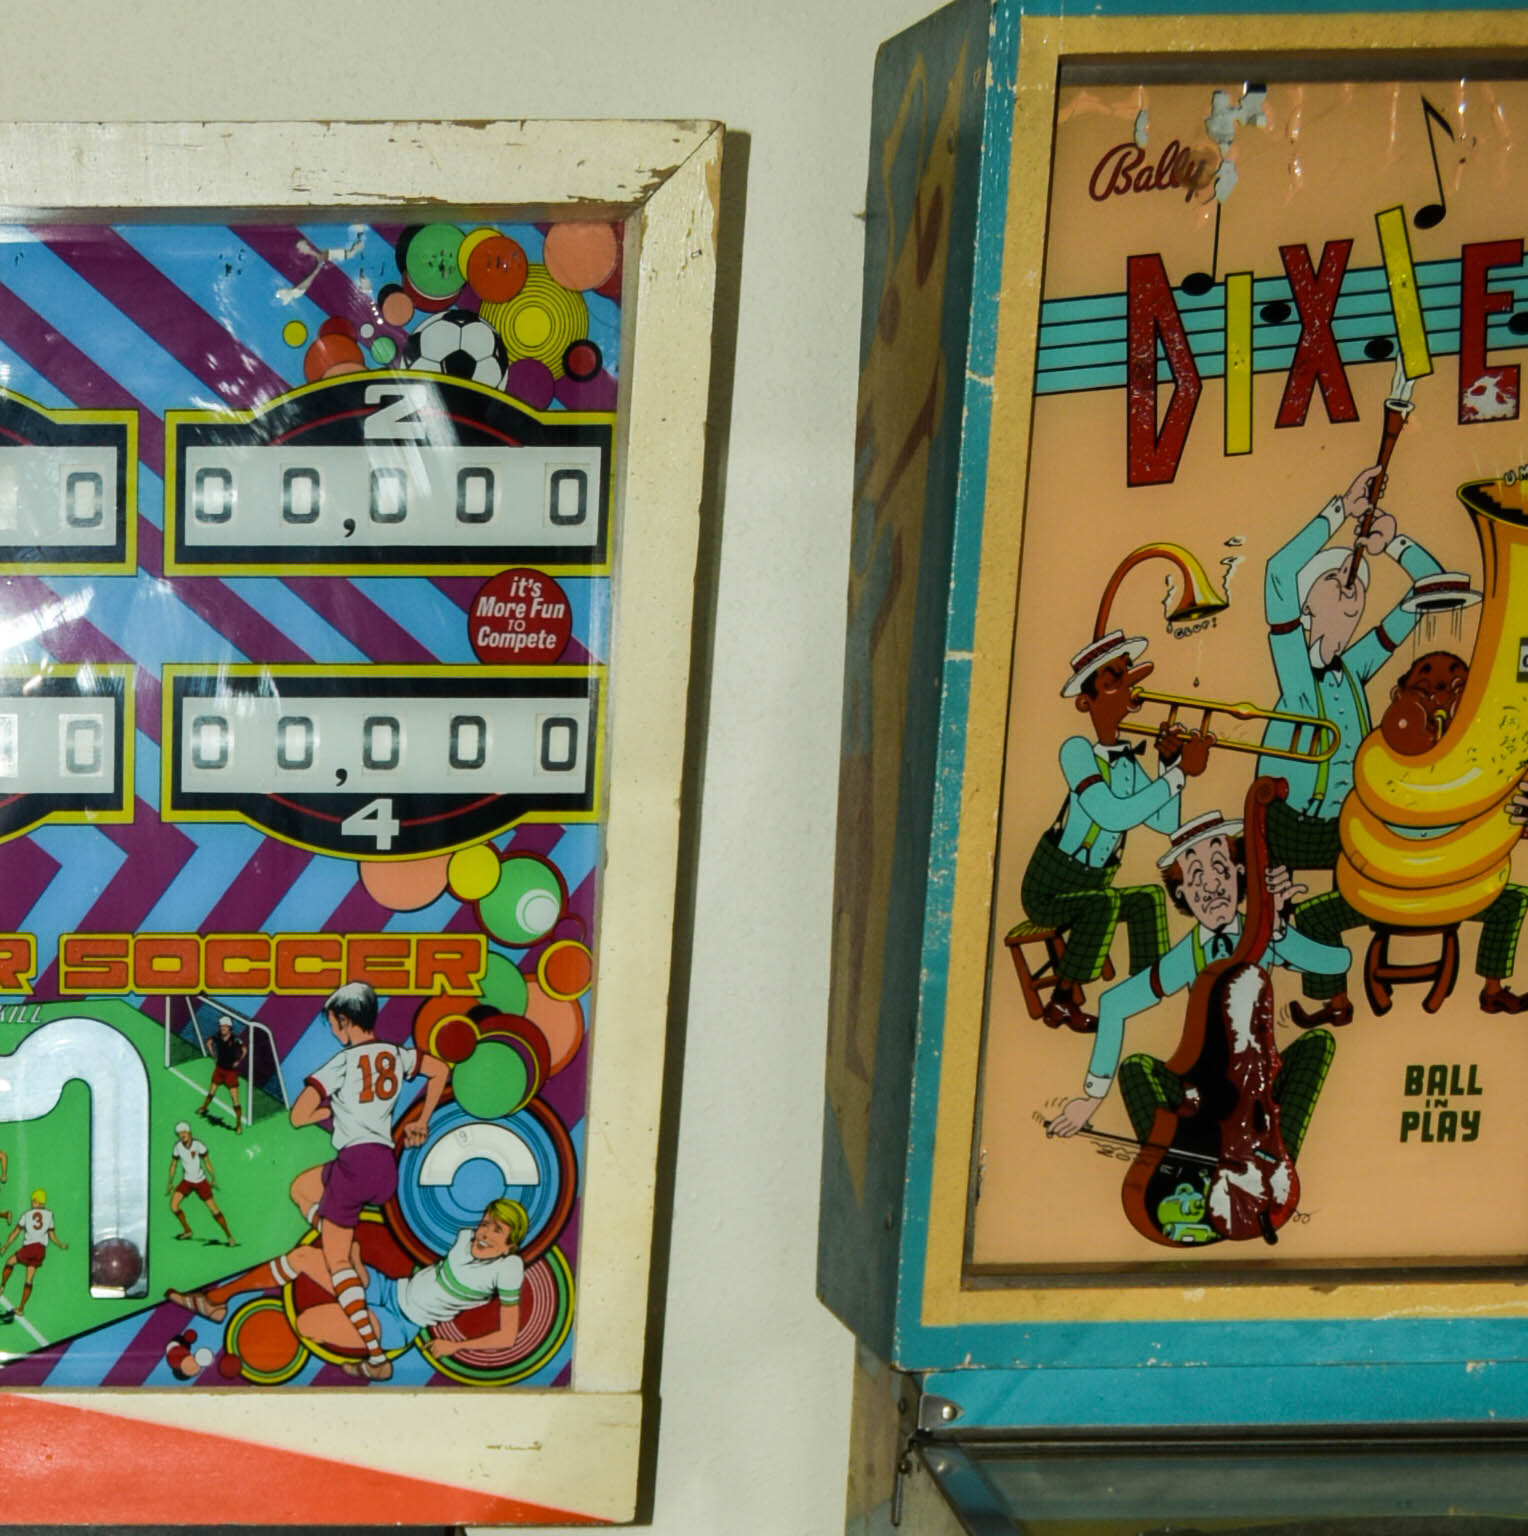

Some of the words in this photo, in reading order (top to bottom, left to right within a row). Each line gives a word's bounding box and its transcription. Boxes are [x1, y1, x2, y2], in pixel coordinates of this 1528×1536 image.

[1088, 139, 1220, 205] Bally
[363, 383, 427, 440] 2
[509, 576, 542, 598] it's
[476, 596, 527, 618] More
[529, 597, 565, 619] Fun
[477, 625, 557, 654] Compete
[508, 619, 526, 632] TO
[340, 797, 400, 851] 4
[59, 933, 488, 997] SOCCER
[355, 1050, 398, 1104] 18
[1403, 1064, 1484, 1098] BALL
[1425, 1099, 1449, 1109] IN
[1399, 1112, 1482, 1143] PLAY
[32, 1211, 44, 1230] 3
